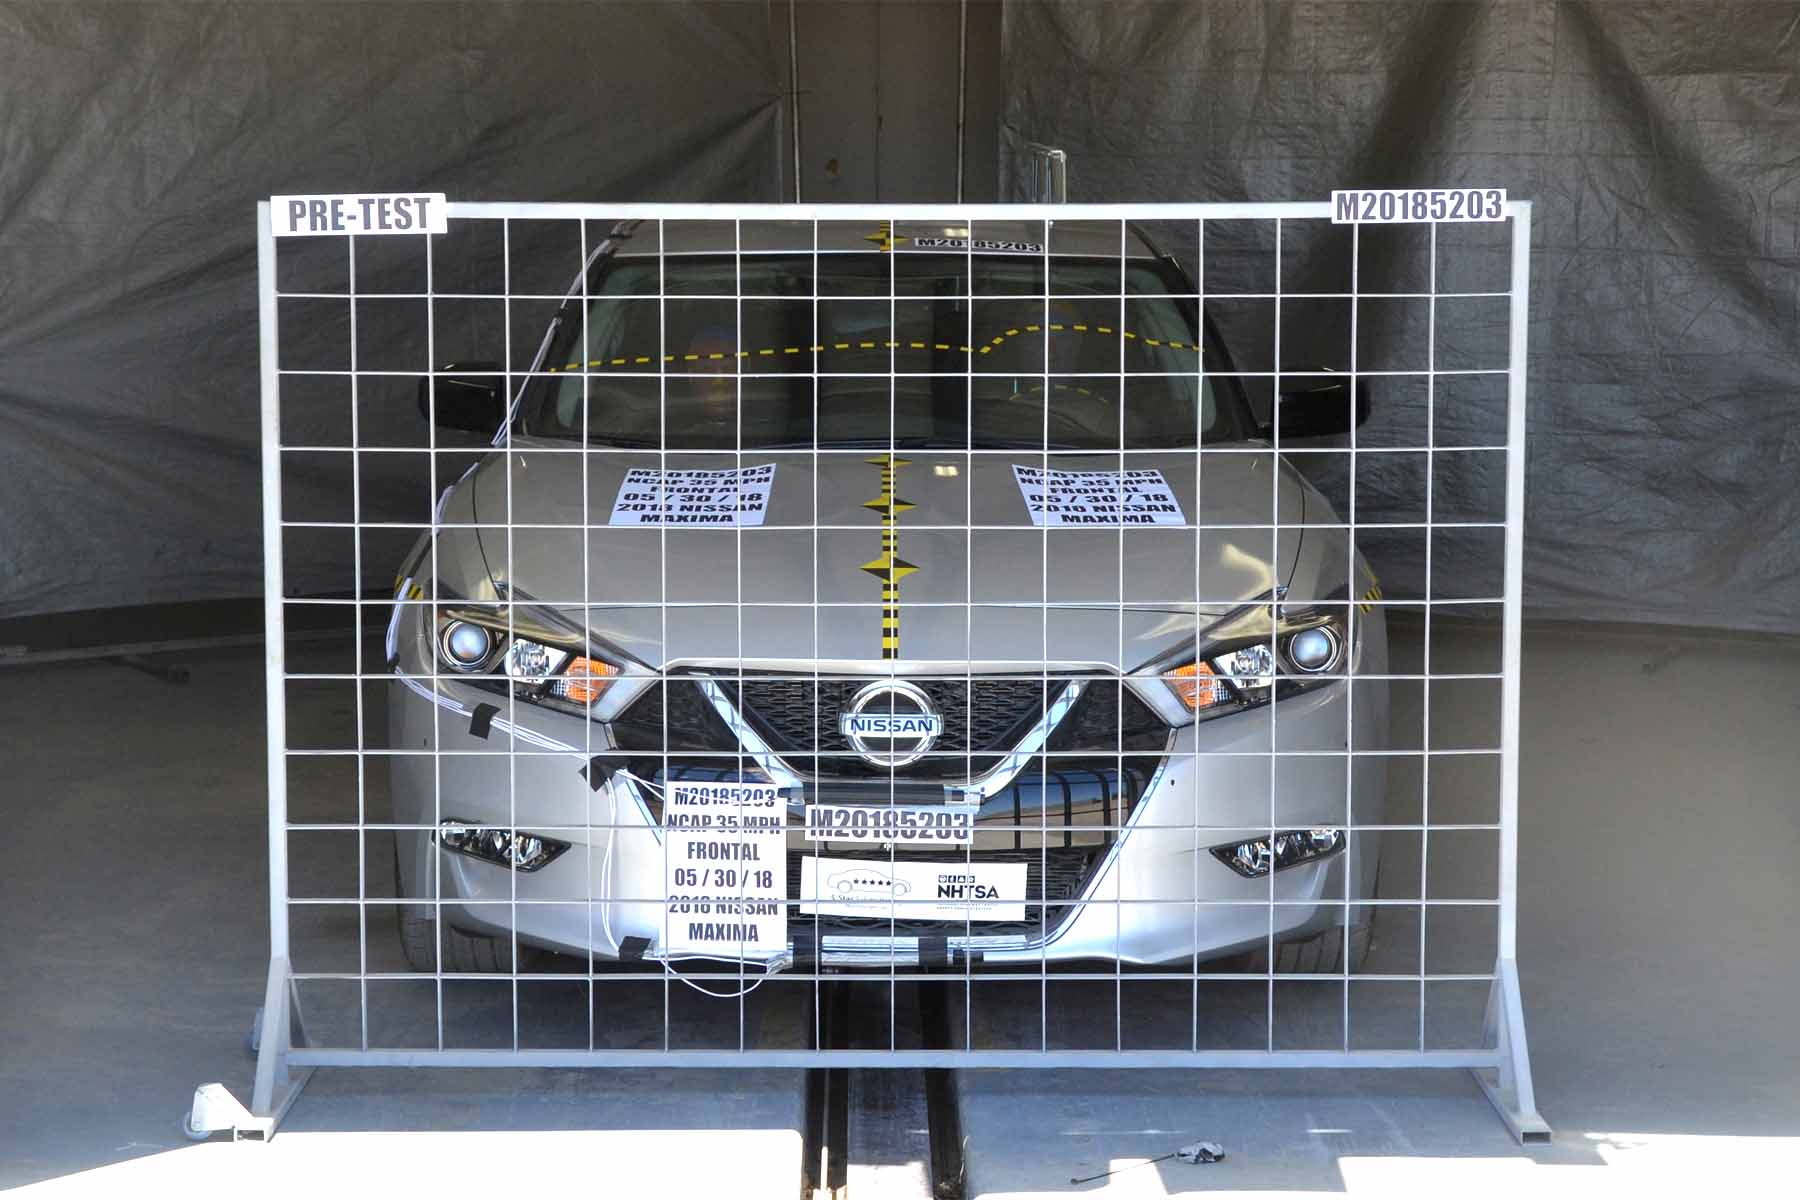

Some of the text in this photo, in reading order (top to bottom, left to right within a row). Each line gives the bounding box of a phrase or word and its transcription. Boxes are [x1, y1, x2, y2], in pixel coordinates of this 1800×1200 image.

[1336, 190, 1502, 221] M20185203
[289, 197, 431, 232] PRE-TEST
[919, 239, 1042, 252] M2085203
[623, 492, 656, 502] 05
[679, 494, 712, 503] 30
[1029, 494, 1062, 503] 05
[1087, 495, 1118, 503] 30
[1140, 494, 1169, 503] 18
[679, 503, 763, 513] NISSAN
[1093, 503, 1177, 513] NISSAN
[639, 514, 734, 524] MAXIMA
[1060, 514, 1156, 524] MAXIMA
[850, 718, 933, 733] NISSAN
[674, 787, 776, 808] M20185203
[667, 813, 781, 835] NCAP 35 MPH
[810, 808, 969, 840] M20185203
[687, 841, 761, 861] FRONTAL
[674, 867, 773, 889] 05 / 30 / 18
[937, 884, 1000, 899] NHTSA
[715, 895, 779, 916] NISSAN
[688, 922, 760, 942] MAXIMA
